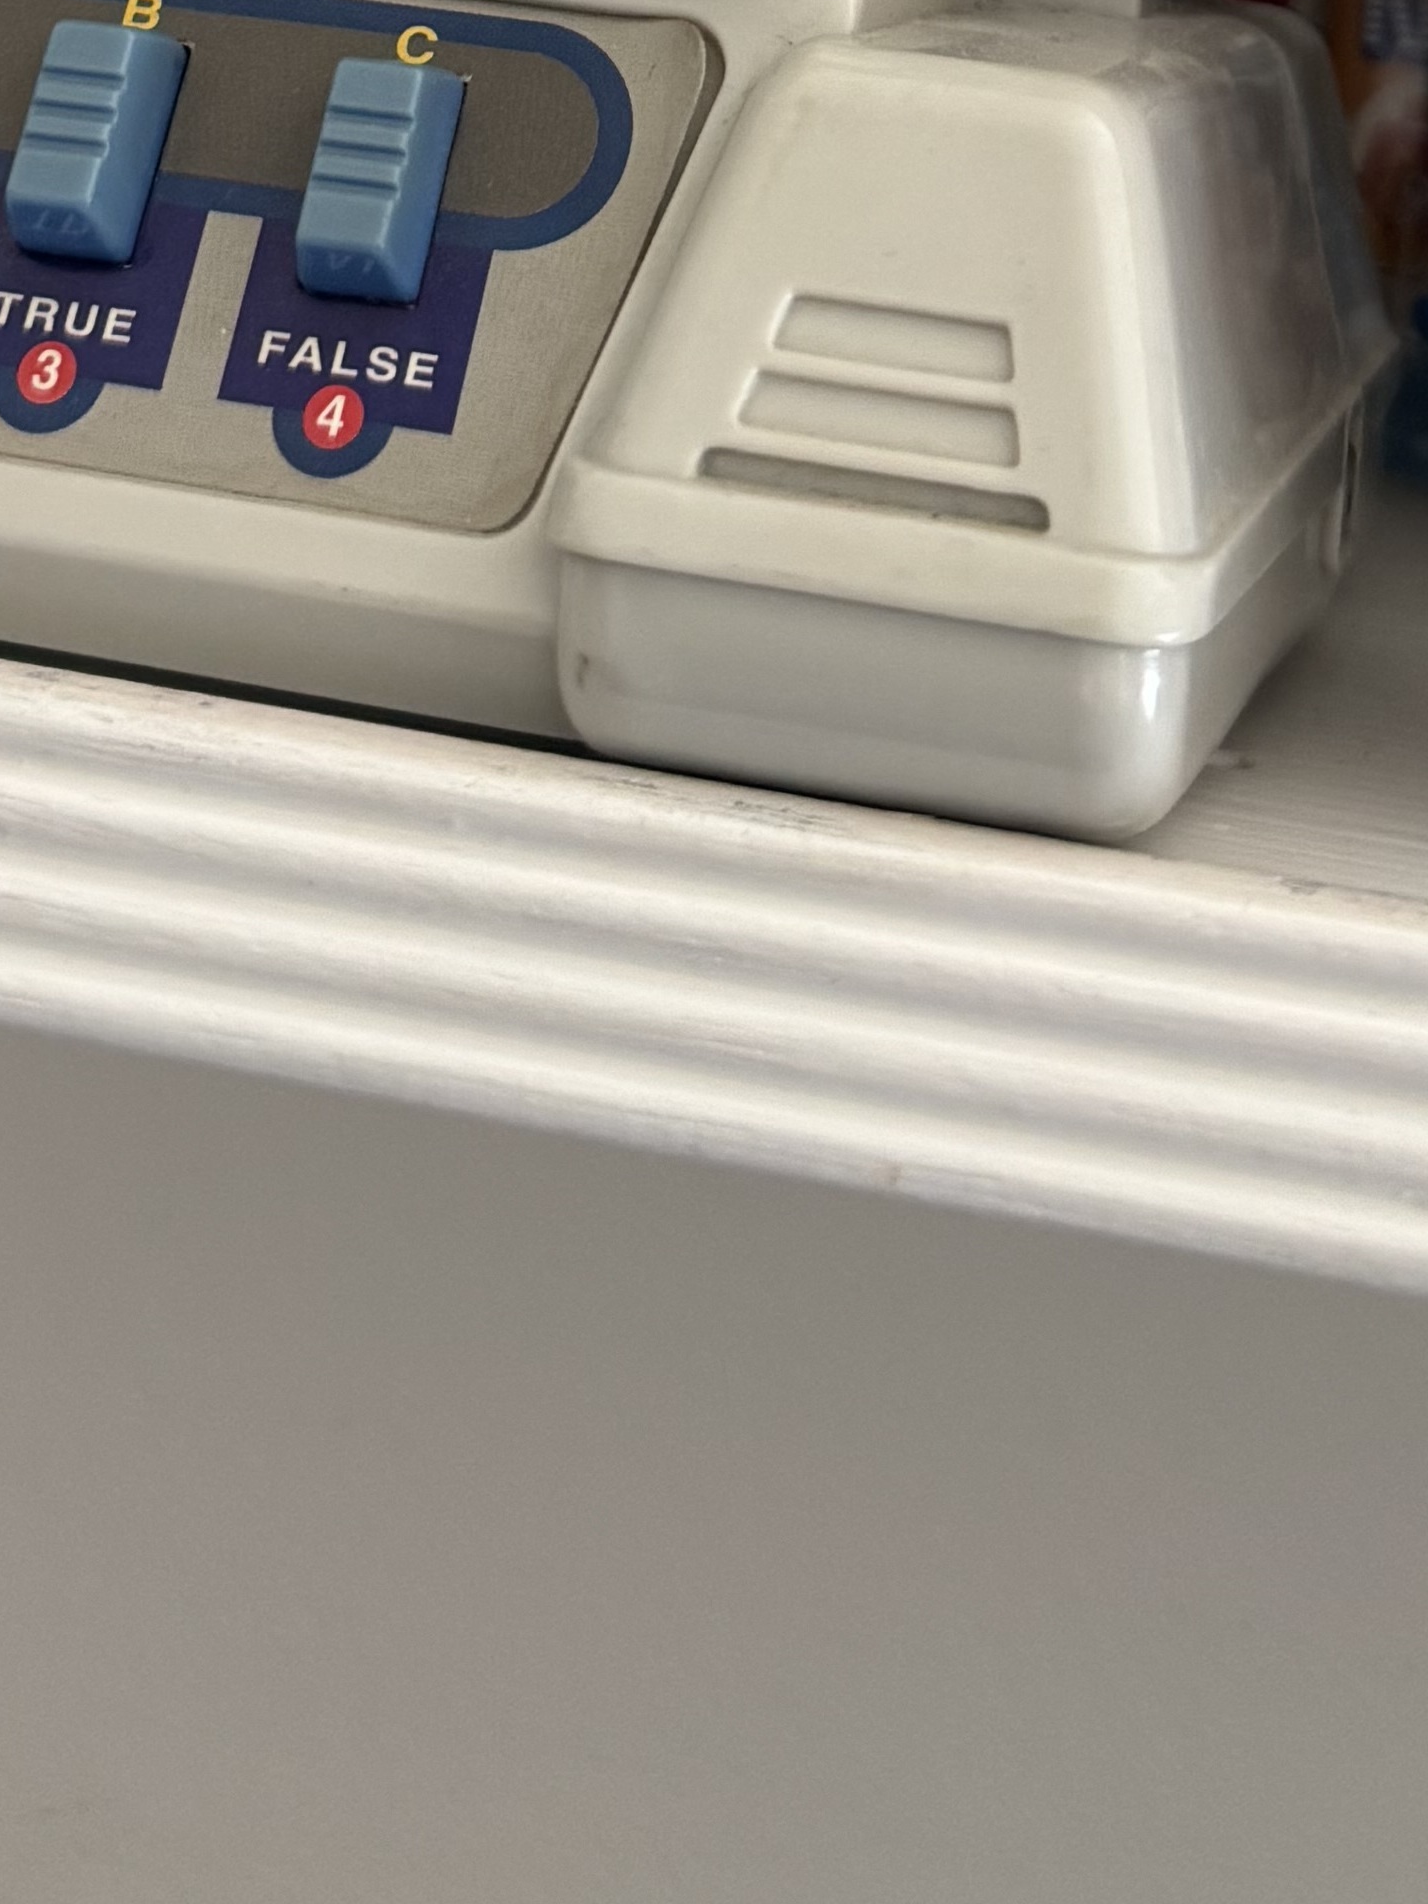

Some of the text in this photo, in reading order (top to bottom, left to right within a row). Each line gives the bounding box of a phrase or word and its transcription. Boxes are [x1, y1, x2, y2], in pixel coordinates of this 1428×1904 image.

[396, 24, 439, 65] C
[31, 348, 62, 391] 3
[256, 329, 440, 390] FALSE
[315, 394, 345, 438] 4
